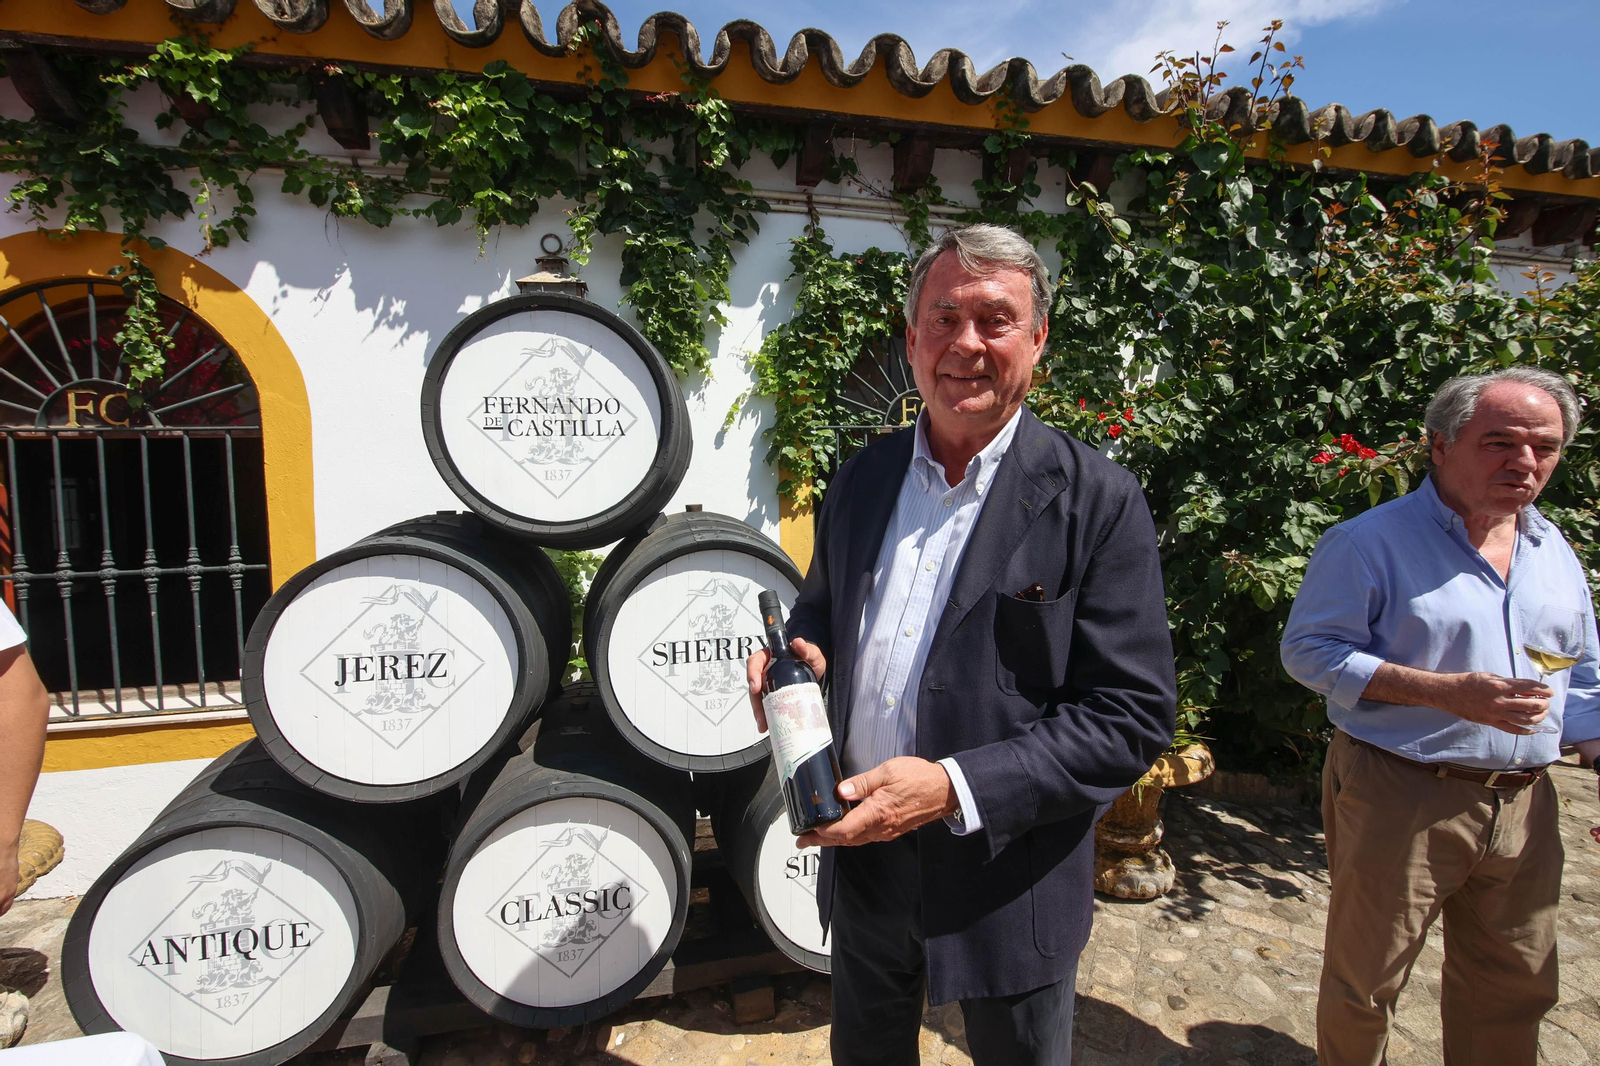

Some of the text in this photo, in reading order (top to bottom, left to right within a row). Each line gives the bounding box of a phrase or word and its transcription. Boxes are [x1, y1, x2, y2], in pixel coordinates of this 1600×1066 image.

[65, 389, 130, 428] FC
[483, 396, 621, 415] FERNANDO
[900, 396, 926, 426] F
[484, 416, 626, 437] DE CASTILLA
[543, 469, 573, 481] 1837
[334, 652, 447, 687] JEREZ
[704, 697, 730, 710] 1837
[381, 718, 413, 732] 1837
[500, 886, 631, 926] CLASSIC
[137, 922, 312, 967] ANTIQUE
[556, 948, 585, 963] 1837
[215, 992, 250, 1010] 1837
